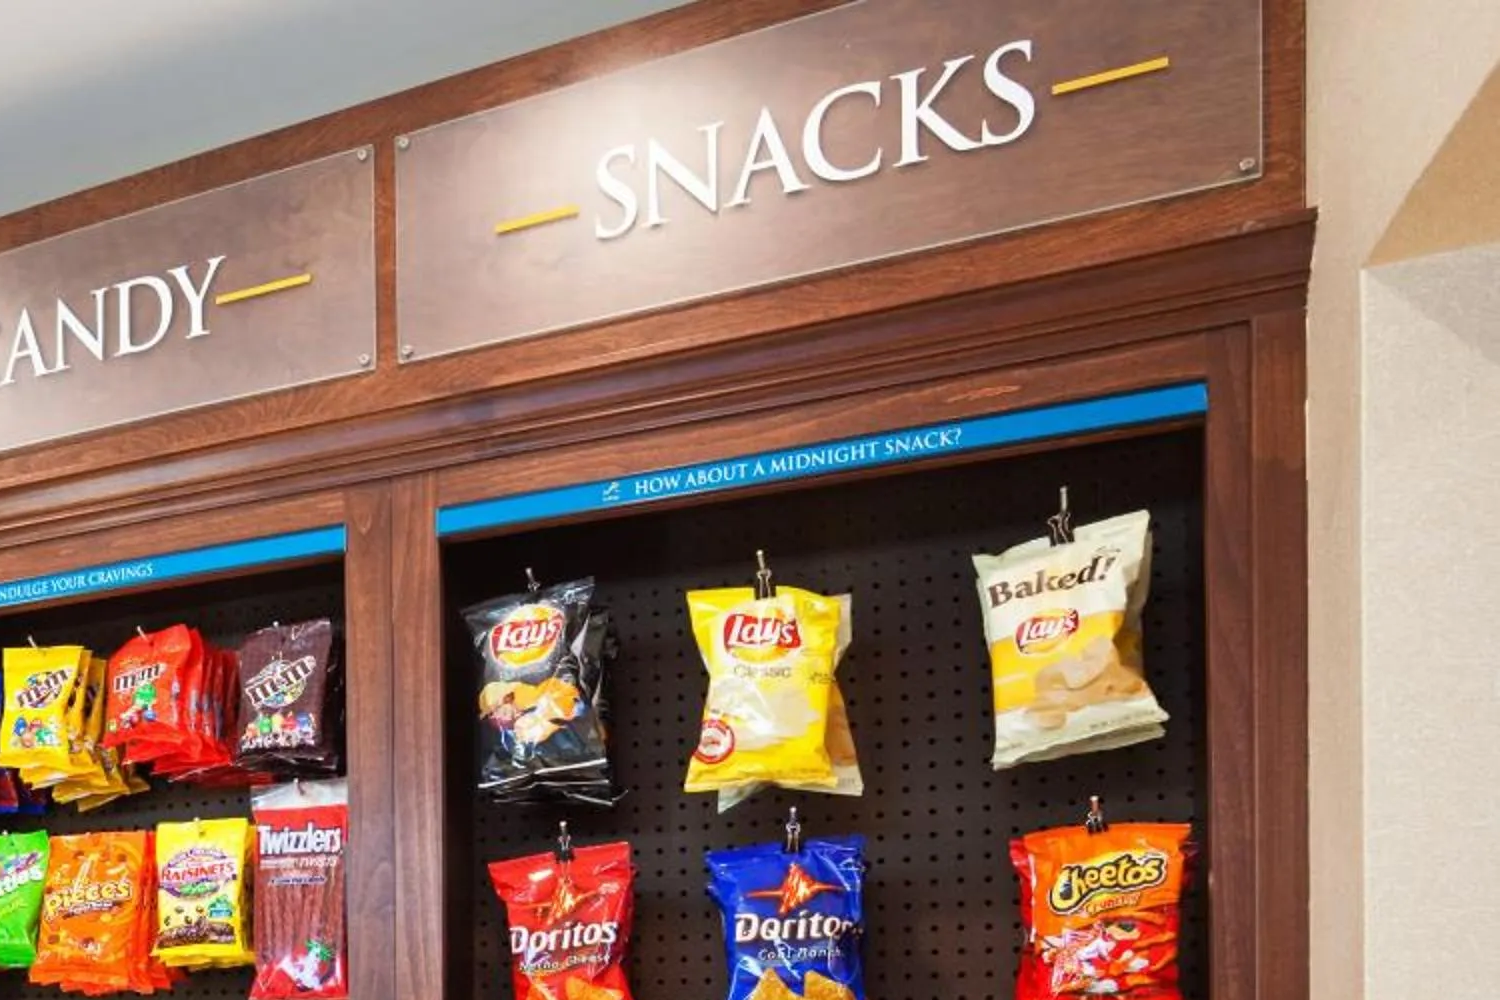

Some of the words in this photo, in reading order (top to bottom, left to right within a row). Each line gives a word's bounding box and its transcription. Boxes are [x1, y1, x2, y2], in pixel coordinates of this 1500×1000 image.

[595, 38, 1036, 240] SNACKS
[634, 475, 681, 495] HOW
[684, 462, 746, 487] ABOUT
[752, 461, 767, 477] A
[770, 441, 879, 474] MIDNIGHT
[883, 427, 962, 456] SNACK?
[50, 574, 86, 593] YOUR
[88, 562, 153, 586] CRAVINGS
[986, 554, 1118, 609] Baked!
[258, 822, 342, 855] Twizzlers
[160, 860, 237, 881] RAISINETS
[1049, 853, 1166, 913] Cheetos
[509, 920, 619, 955] Doritos
